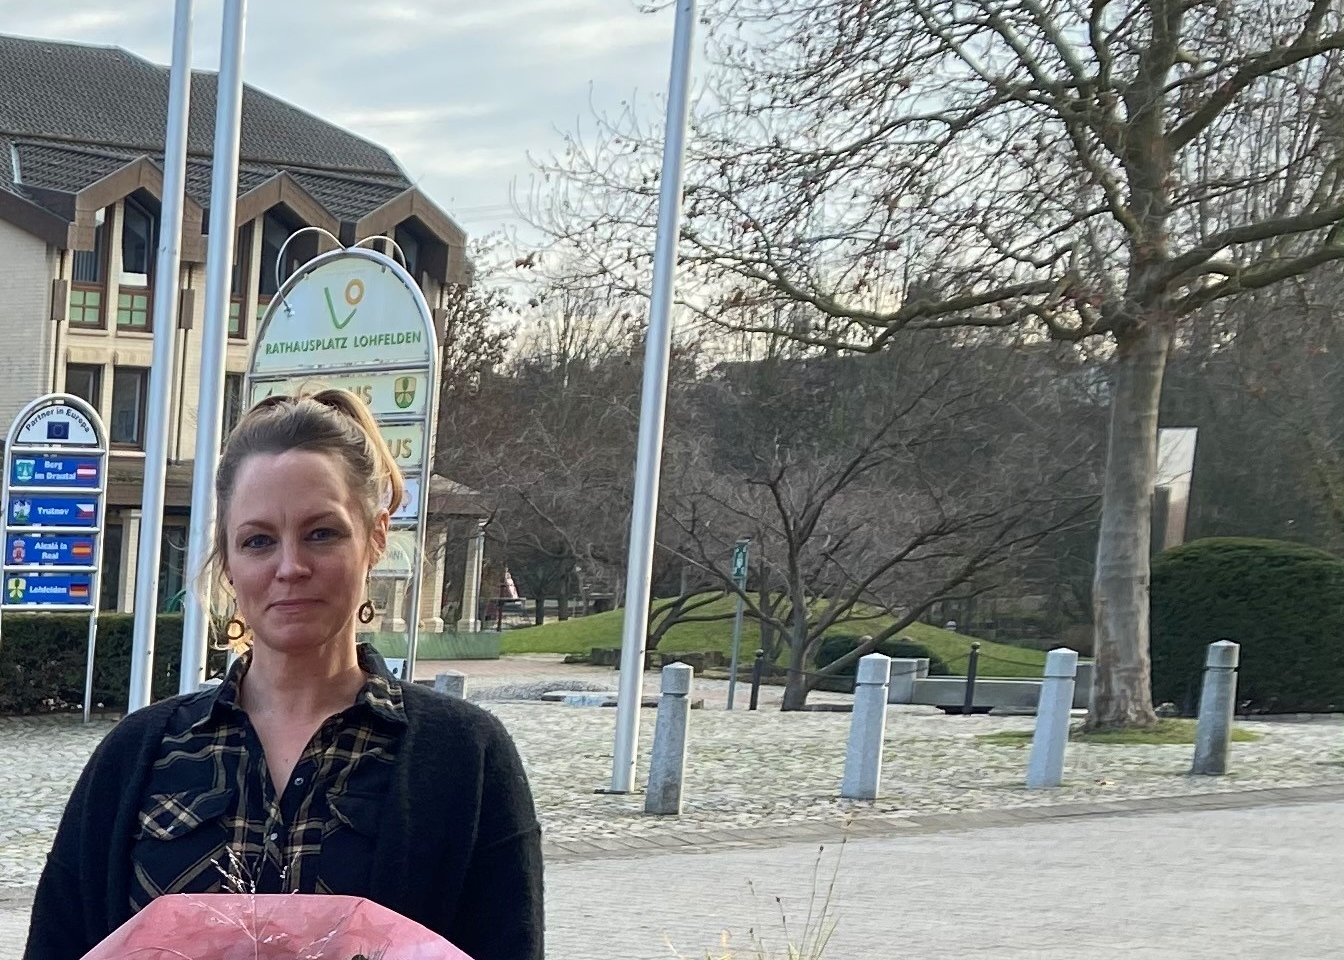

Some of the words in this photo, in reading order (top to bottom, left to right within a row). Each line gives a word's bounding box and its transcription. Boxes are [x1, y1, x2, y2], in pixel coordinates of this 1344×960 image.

[265, 337, 349, 355] RATHAUSPLATZ
[353, 331, 422, 348] LOHFELDEN
[25, 409, 54, 432] Partner
[56, 407, 64, 415] in
[66, 408, 90, 433] Europa
[44, 460, 63, 471] Berg
[34, 471, 45, 480] im
[41, 552, 60, 560] Real
